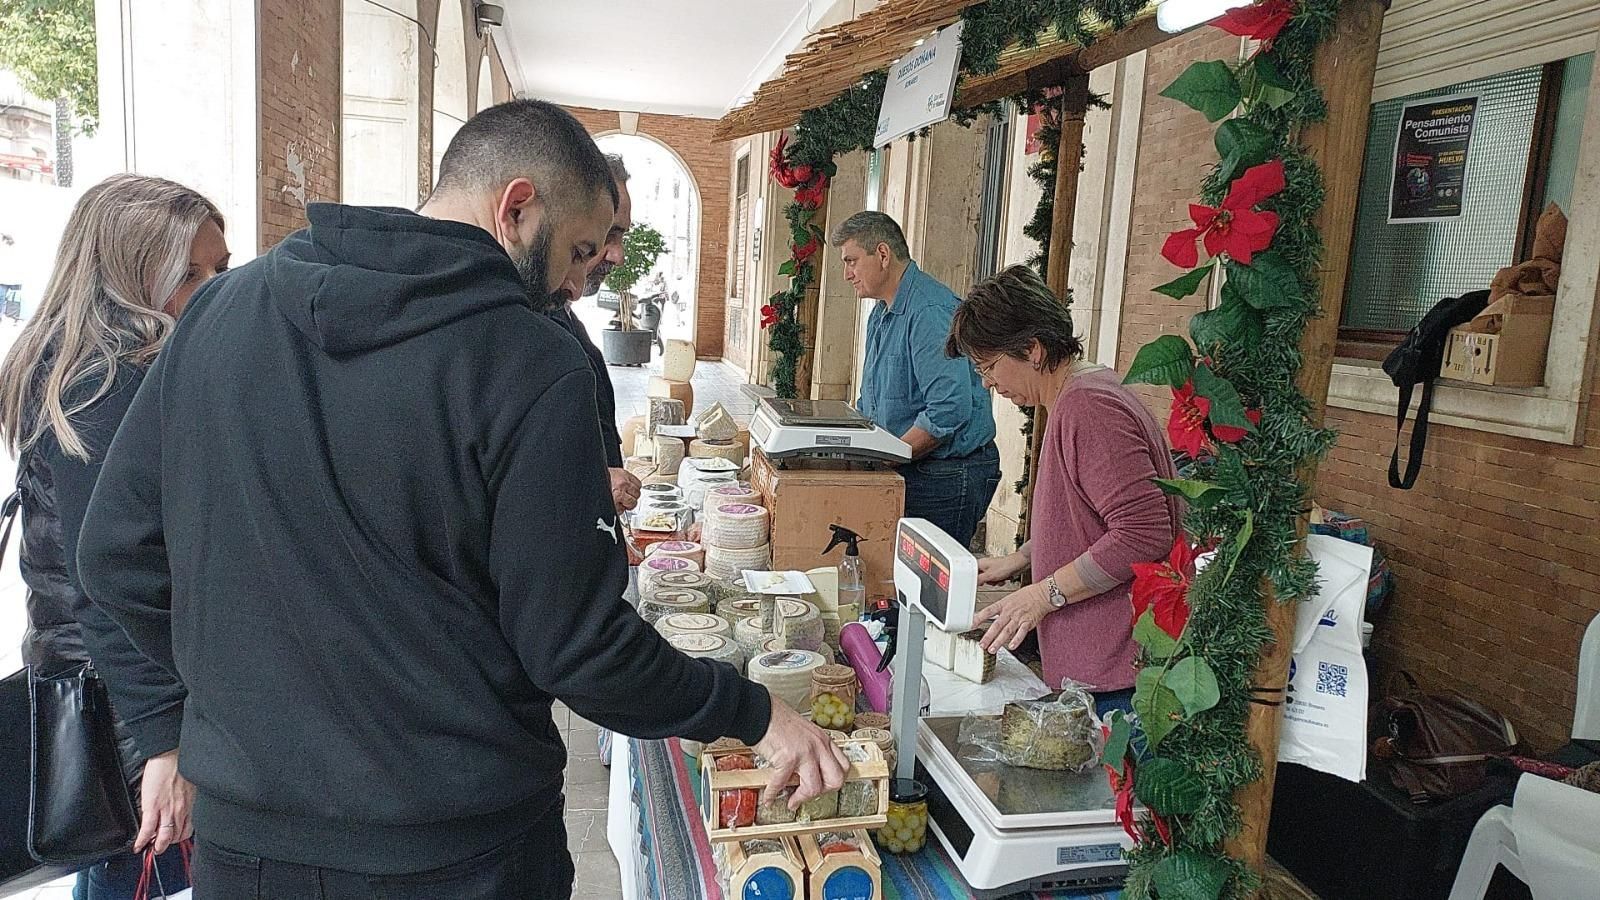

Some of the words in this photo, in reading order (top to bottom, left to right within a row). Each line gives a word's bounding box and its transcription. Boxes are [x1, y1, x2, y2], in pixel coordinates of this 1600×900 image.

[1431, 104, 1473, 116] PRESENTACIÓN
[1405, 113, 1471, 130] Pensamiento
[1415, 123, 1469, 139] Comunista
[1438, 155, 1464, 164] HUELVA
